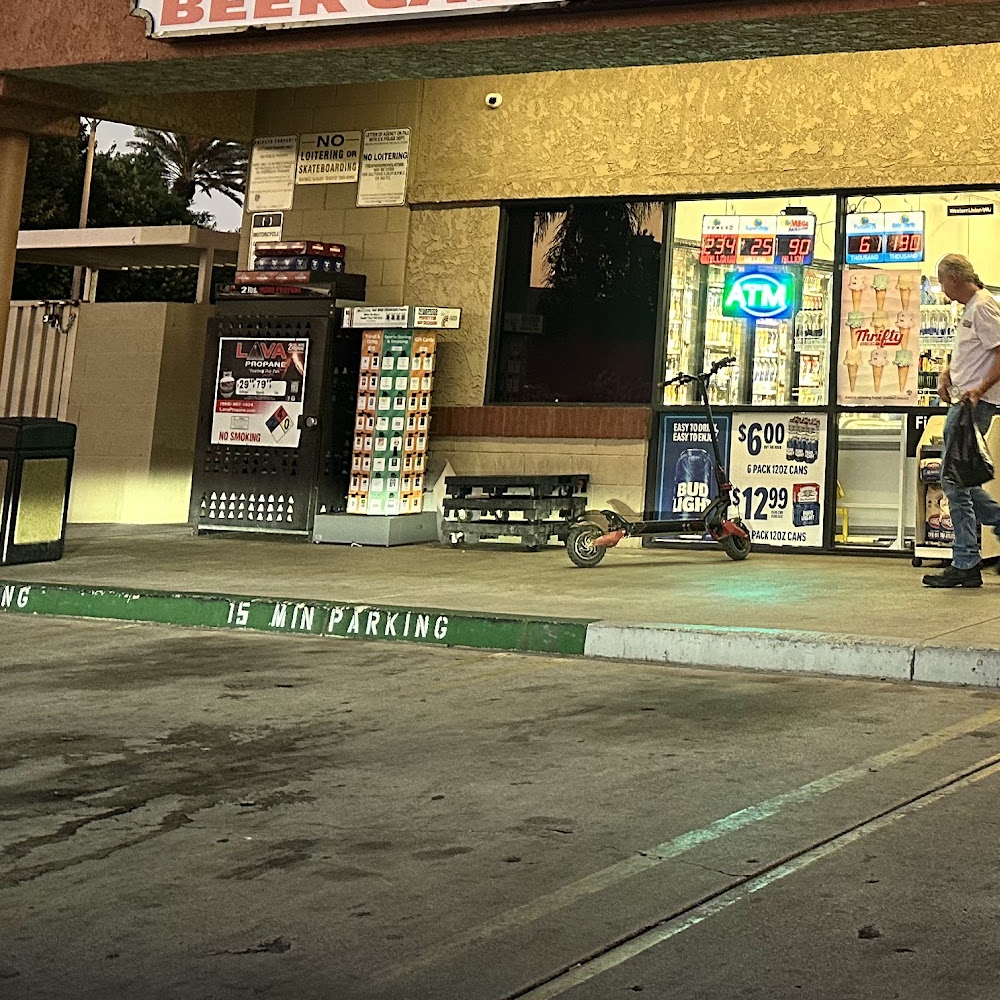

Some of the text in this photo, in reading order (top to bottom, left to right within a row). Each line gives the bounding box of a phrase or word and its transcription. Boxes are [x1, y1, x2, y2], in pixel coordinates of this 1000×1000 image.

[317, 134, 345, 148] NO
[300, 149, 357, 161] LOITERING OR
[363, 151, 409, 161] NO LOITERING
[298, 162, 357, 174] SKATEBOARDING
[702, 238, 736, 255] 234
[750, 239, 773, 255] 25
[789, 239, 812, 256] 90
[725, 282, 787, 307] ATM
[855, 329, 904, 348] Thrifty
[235, 342, 288, 360] LAVA
[244, 360, 287, 368] PROPANE
[673, 423, 690, 432] EASY
[690, 423, 699, 432] TO
[219, 431, 261, 442] NO SMOKING
[672, 432, 689, 442] EASY
[689, 432, 698, 442] TO
[752, 464, 771, 474] PACK
[789, 465, 808, 475] CANS
[677, 482, 709, 497] BUD
[751, 531, 768, 541] PACK
[787, 531, 806, 542] CANS
[227, 601, 449, 639] 15 MIN PARKING
